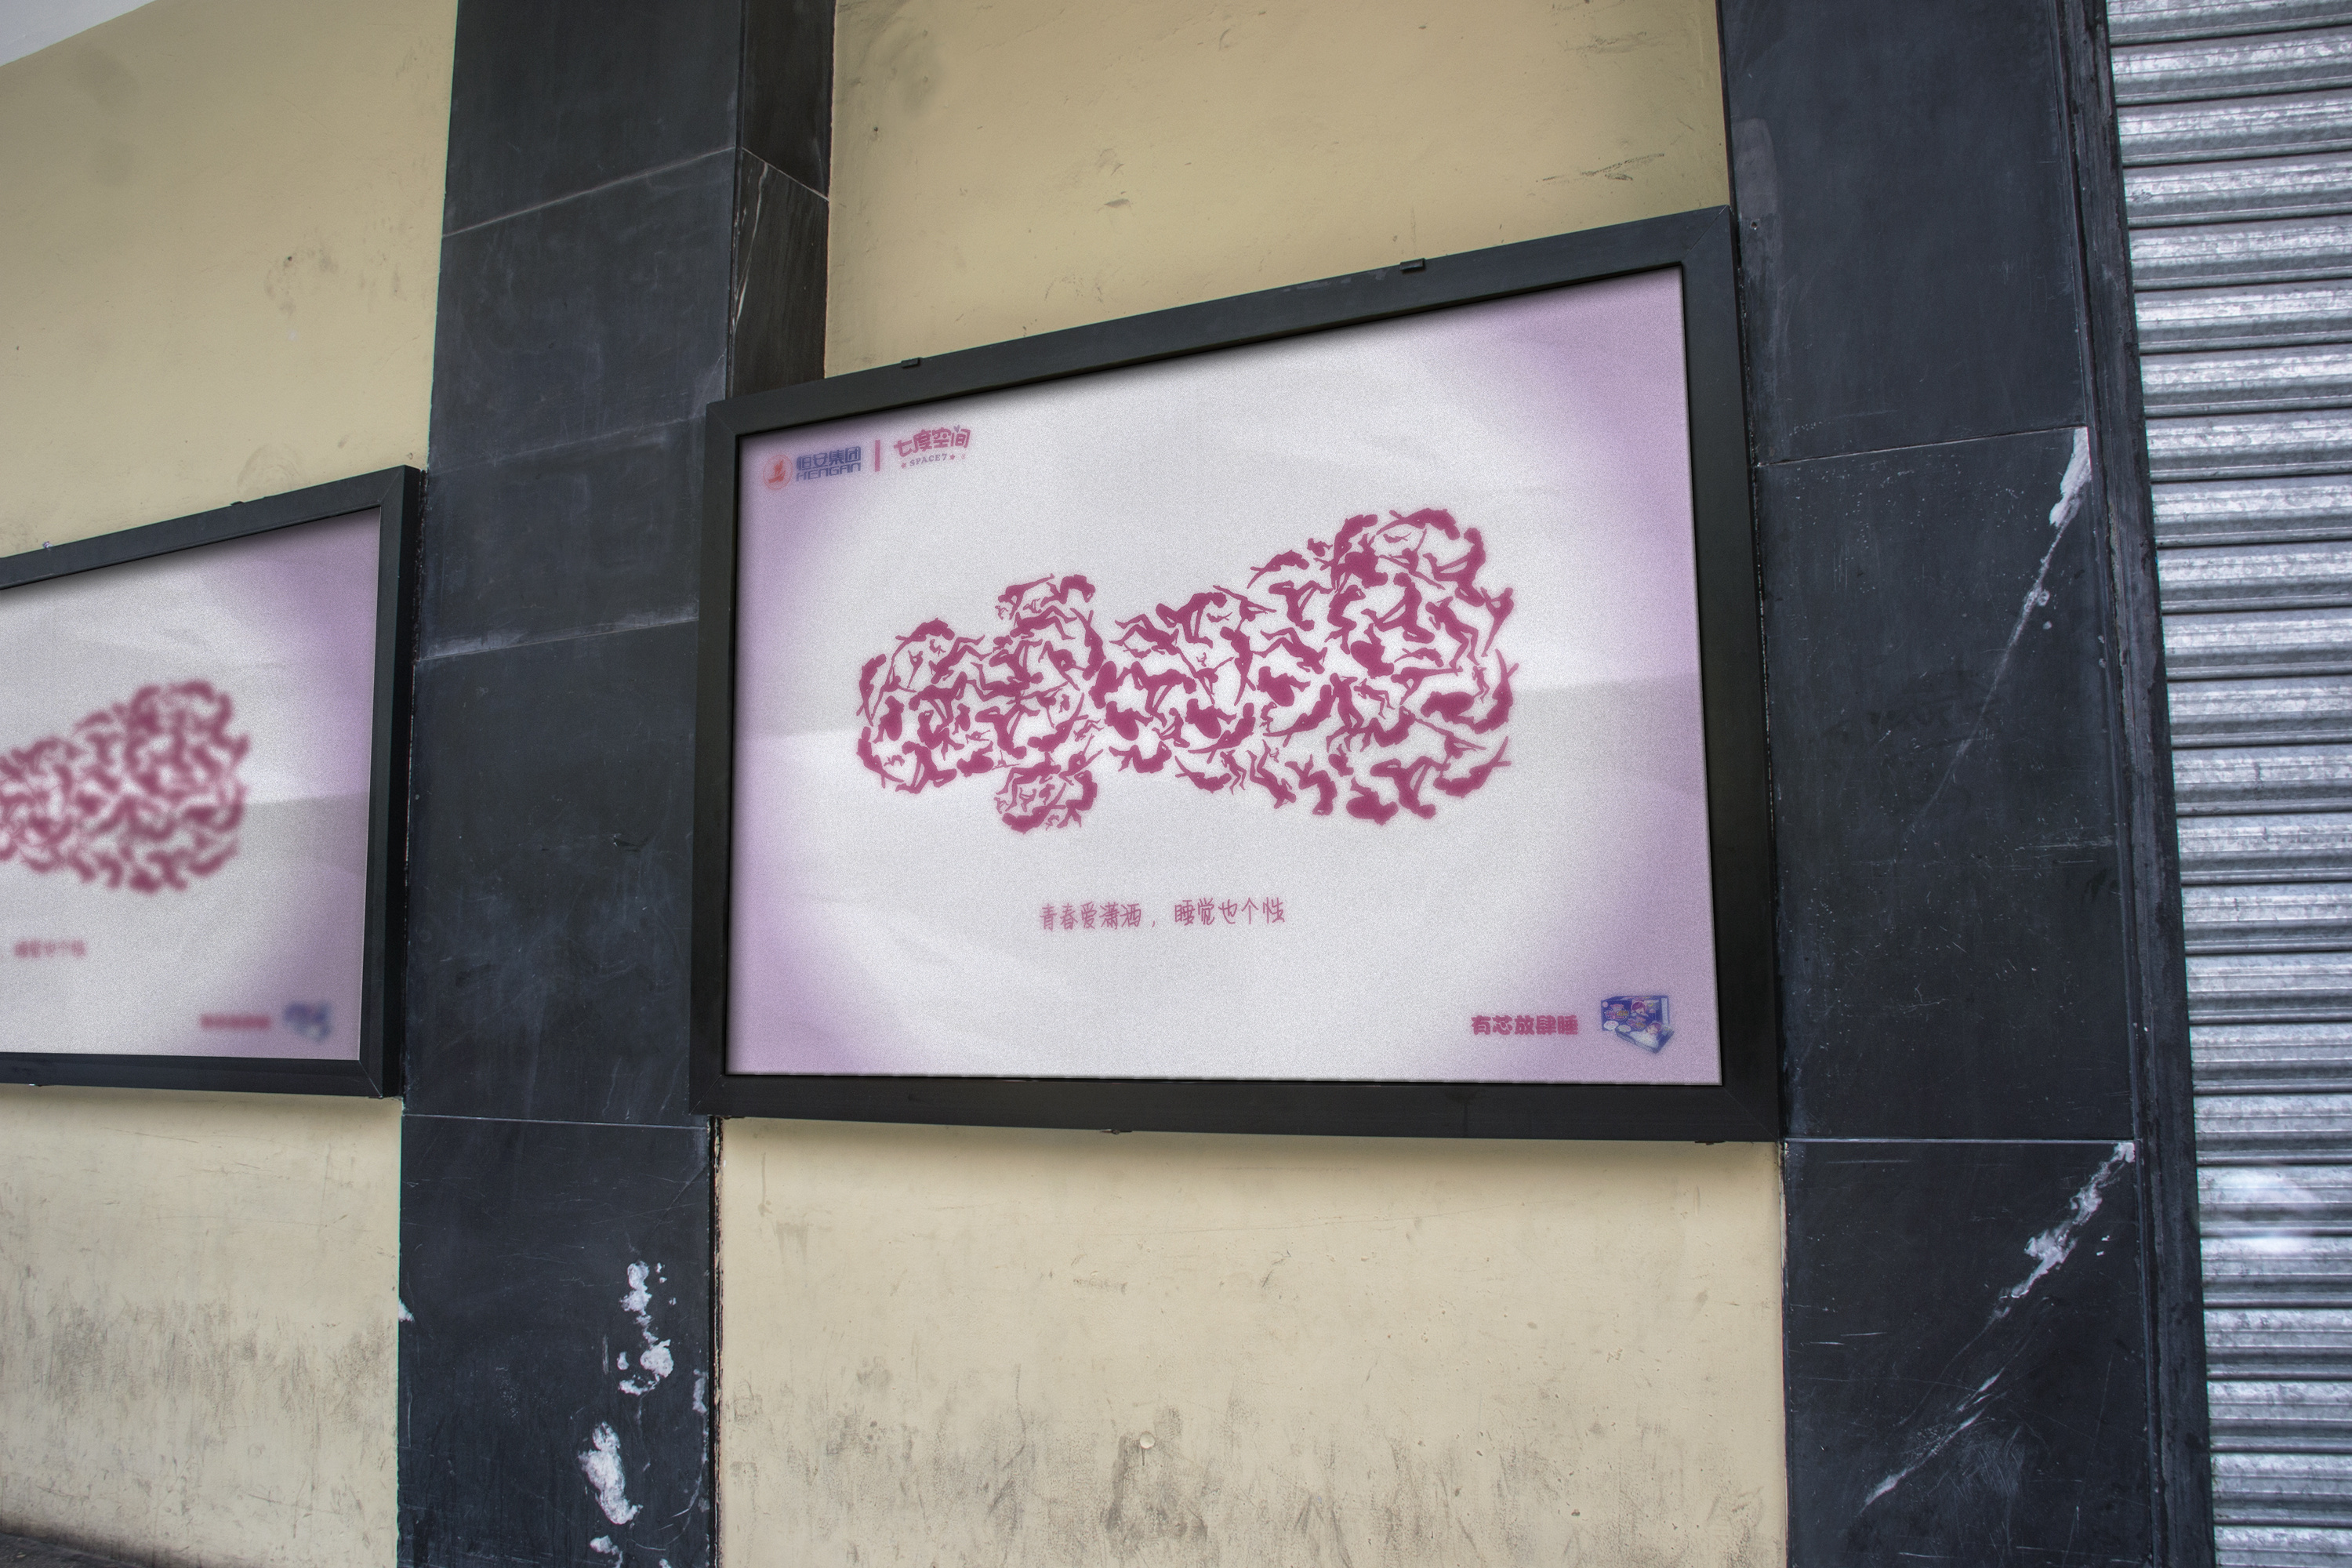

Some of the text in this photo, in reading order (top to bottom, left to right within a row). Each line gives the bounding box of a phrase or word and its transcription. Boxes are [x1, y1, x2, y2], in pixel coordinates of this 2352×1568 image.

[894, 427, 971, 457] 七度空间
[796, 446, 862, 471] 恒安集团
[1471, 1014, 1579, 1036] 有芯放肆睡
